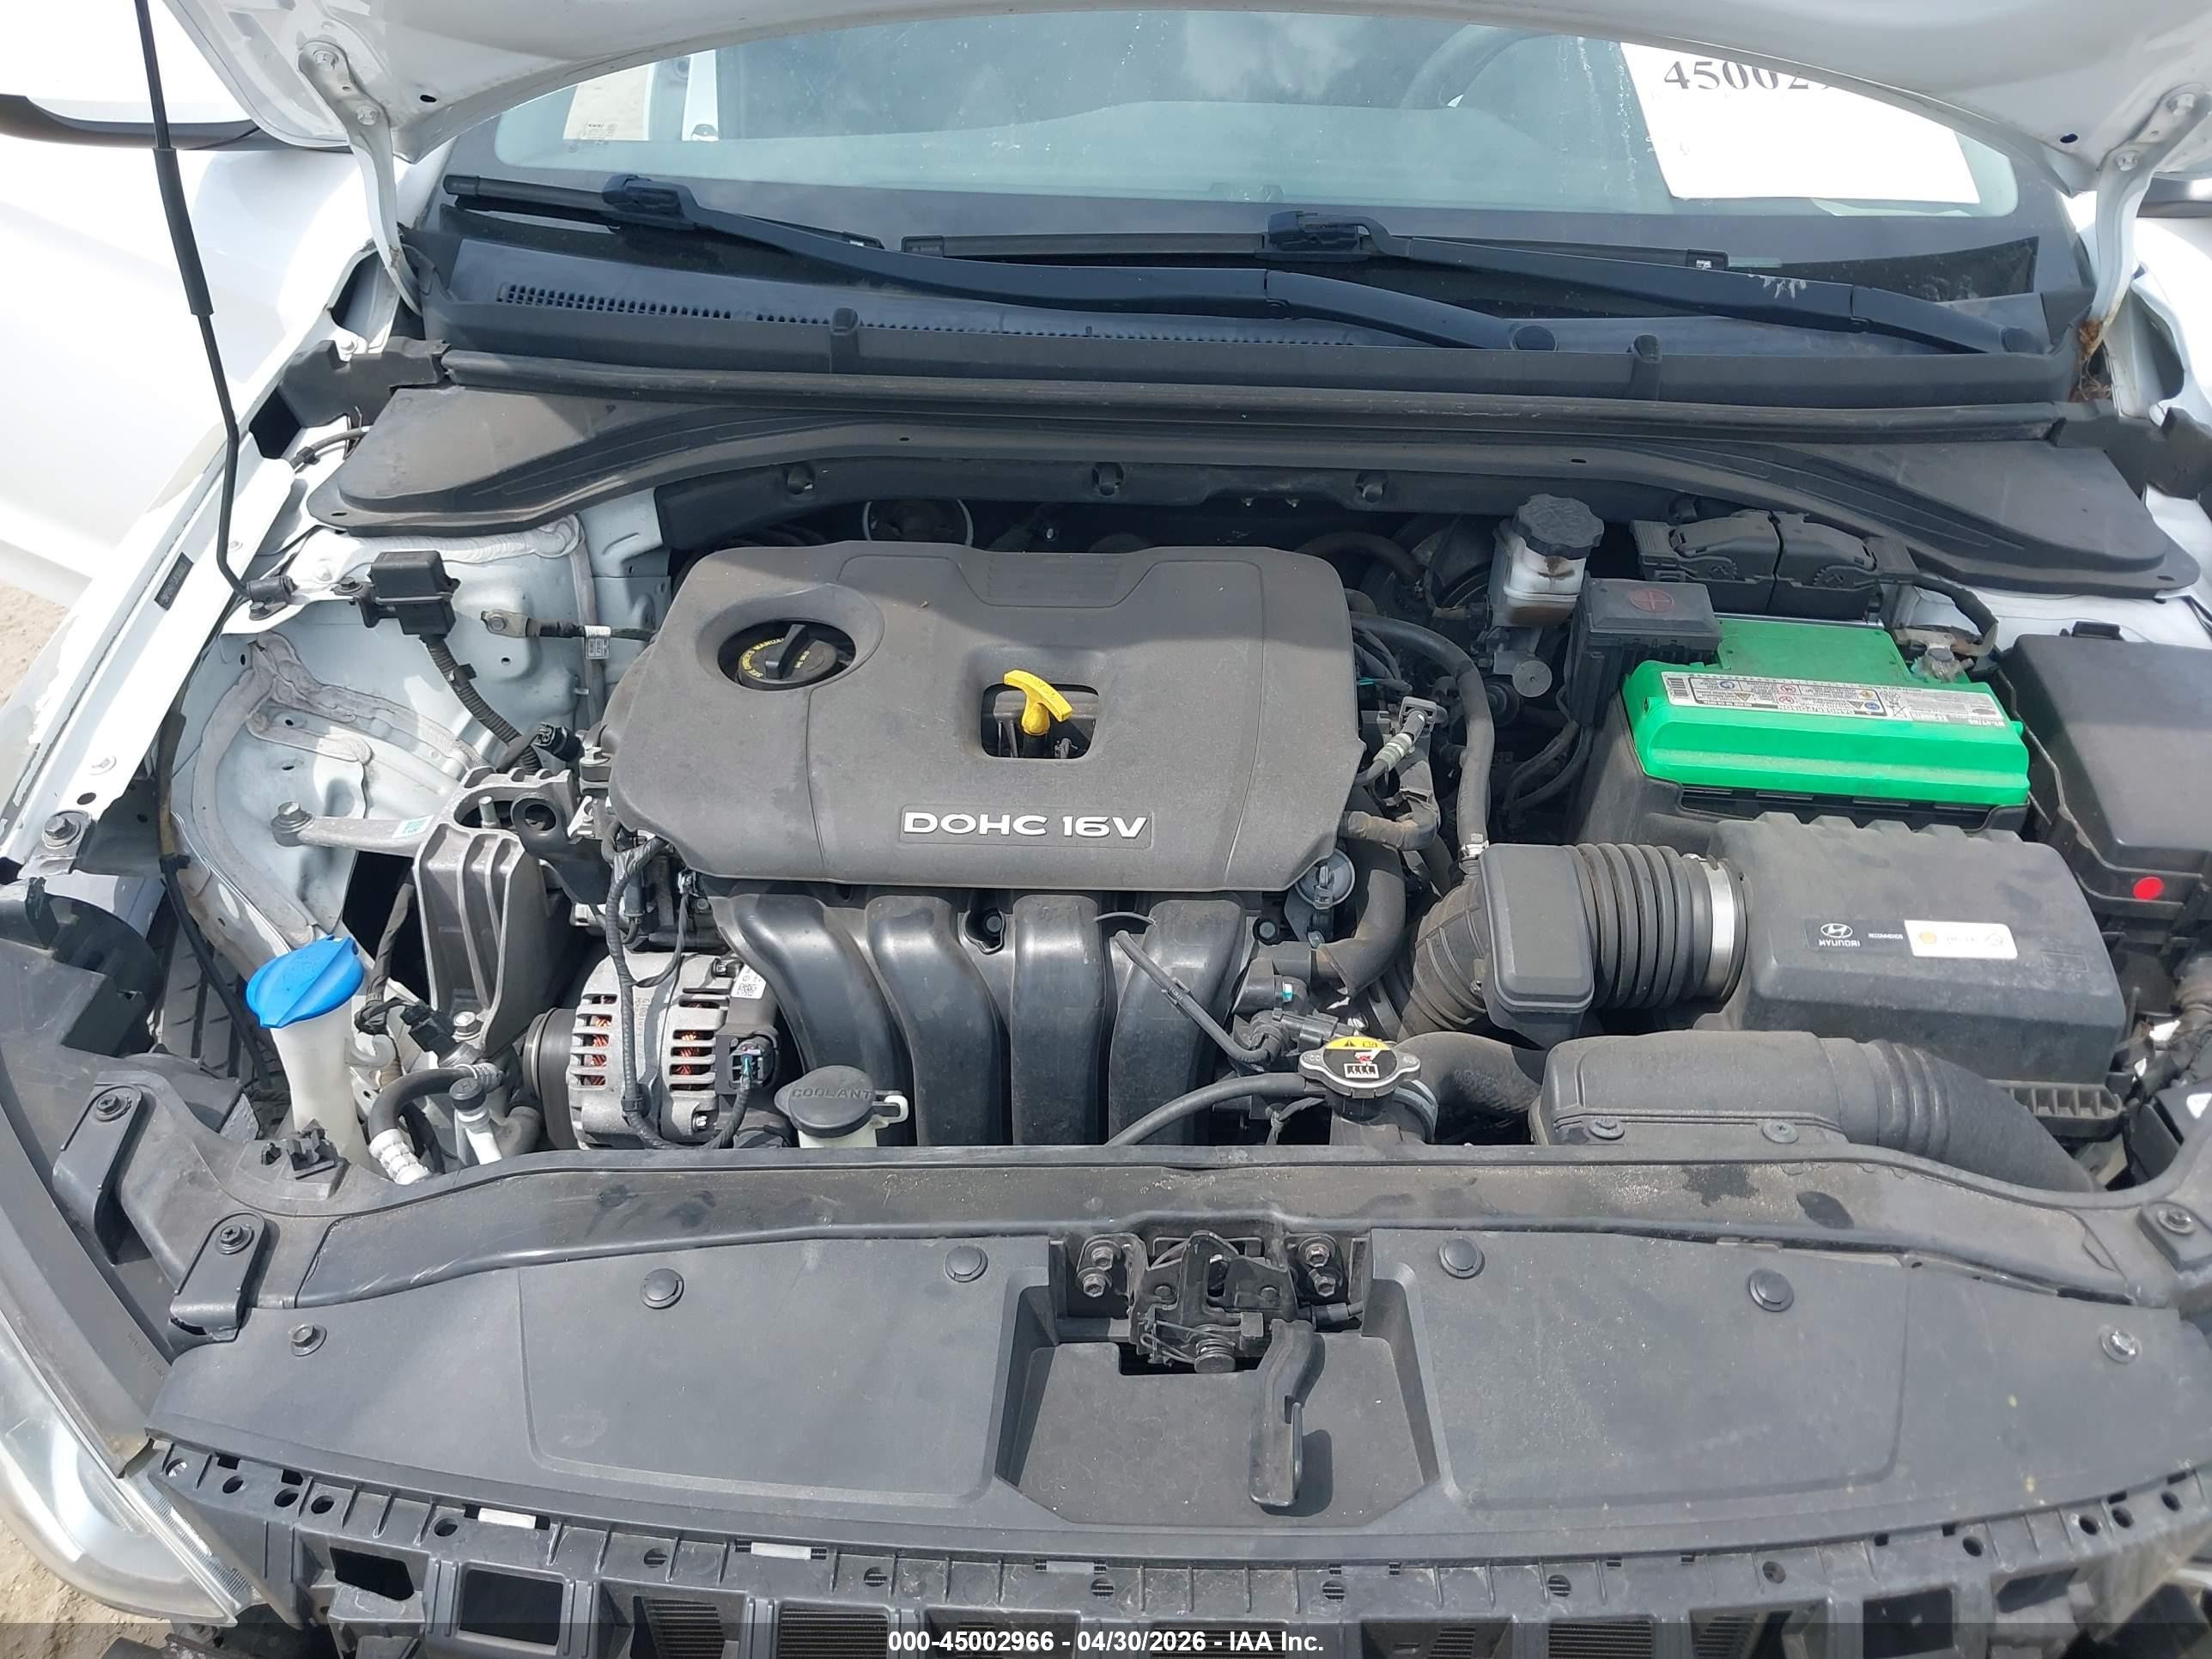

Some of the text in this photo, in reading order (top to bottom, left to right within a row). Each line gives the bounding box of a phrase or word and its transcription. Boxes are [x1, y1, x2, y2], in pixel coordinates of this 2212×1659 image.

[902, 811, 1148, 839] DOHC 16V
[1818, 939, 1861, 947] HYUNDAI
[792, 1087, 872, 1100] COOLANT
